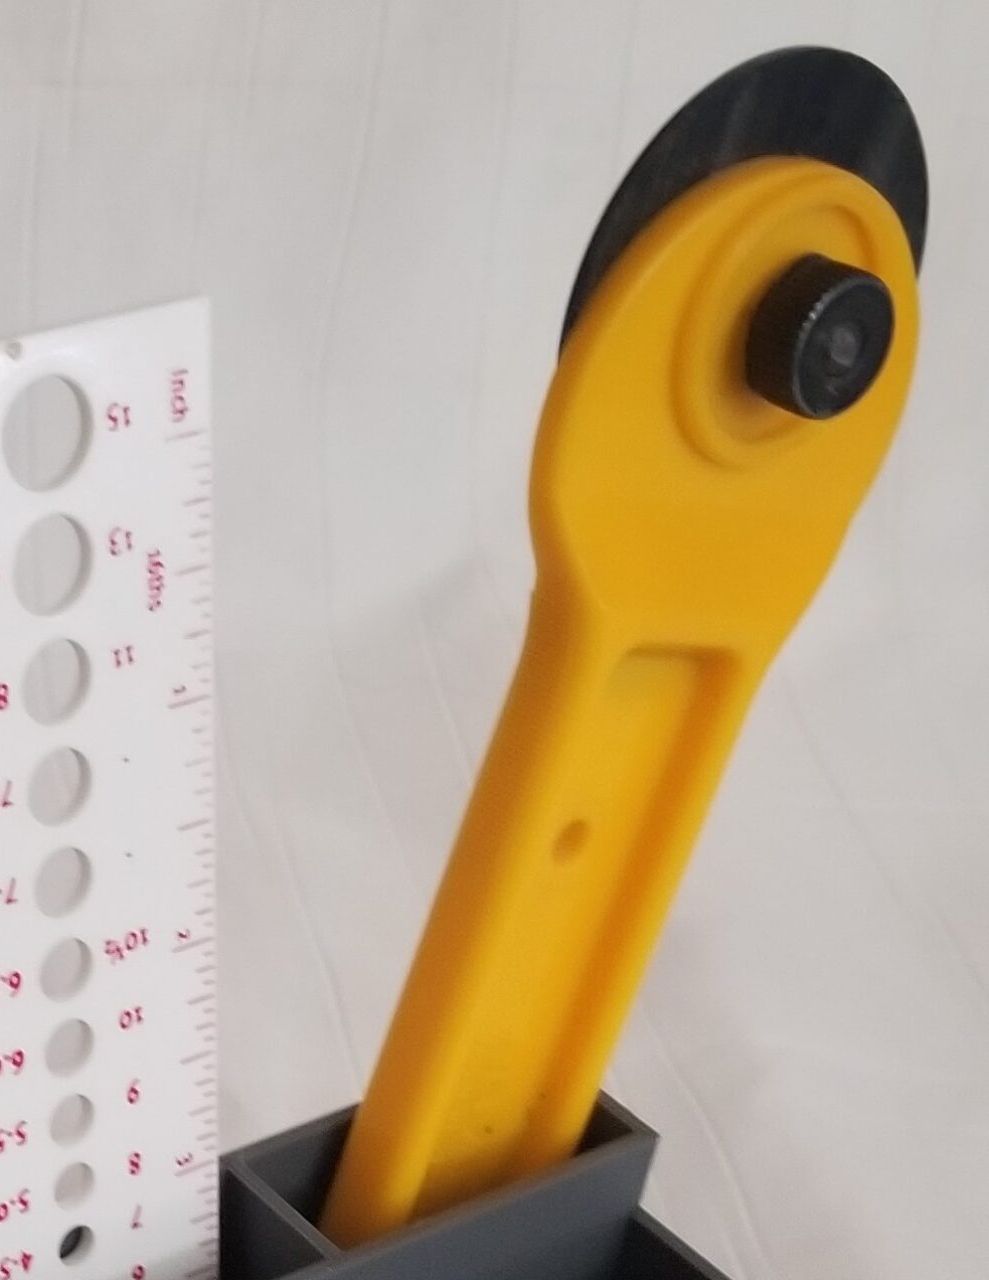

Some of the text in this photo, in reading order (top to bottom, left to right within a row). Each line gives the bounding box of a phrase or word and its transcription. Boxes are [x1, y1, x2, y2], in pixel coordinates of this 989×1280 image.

[171, 368, 188, 422] Inch
[106, 403, 131, 431] 15
[108, 527, 133, 556] 13
[113, 645, 135, 668] 11
[119, 1007, 143, 1029] 10
[127, 1078, 140, 1104] 9
[129, 1152, 141, 1175] 8
[132, 1204, 142, 1230] 7
